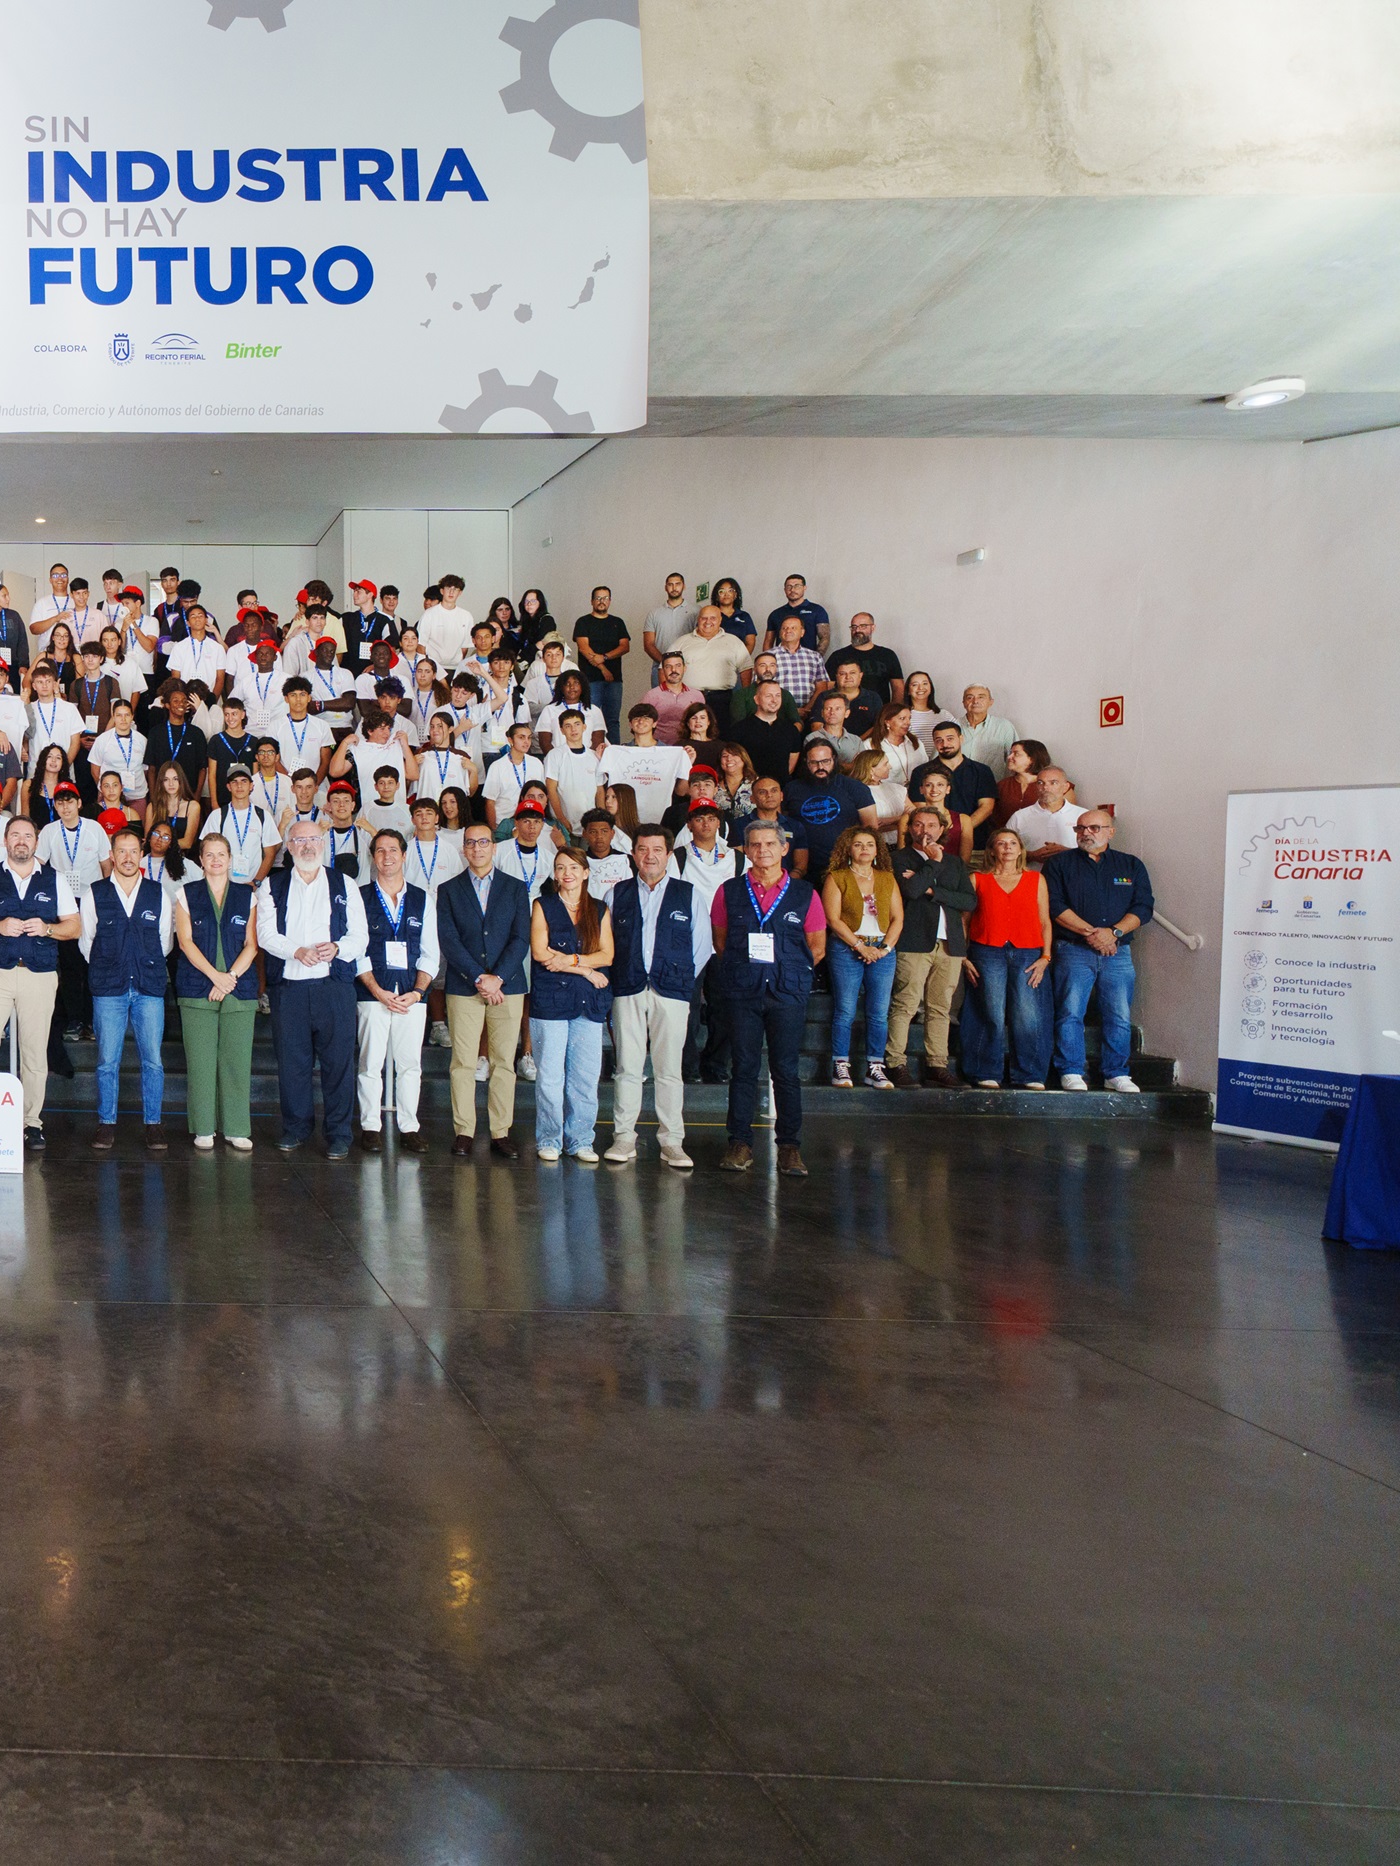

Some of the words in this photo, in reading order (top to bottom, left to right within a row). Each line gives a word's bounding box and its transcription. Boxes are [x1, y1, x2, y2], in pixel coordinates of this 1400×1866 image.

[24, 116, 90, 143] SIN
[28, 148, 489, 204] INDUSTRIA
[26, 208, 88, 238] NO
[105, 208, 187, 238] HAY
[28, 245, 375, 306] FUTURO
[34, 344, 88, 353] COLABORA
[225, 342, 282, 359] Binter
[0, 404, 49, 417] Industria,
[53, 404, 105, 416] Comercio
[108, 408, 115, 419] y
[118, 404, 182, 416] Autónomos
[185, 404, 202, 416] del
[204, 404, 255, 416] Gobierno
[258, 404, 272, 416] de
[275, 404, 325, 416] Canarias
[1274, 837, 1290, 845] DÍA
[1275, 849, 1392, 862] INDUSTRIA
[1274, 863, 1364, 880] Canaria
[1338, 909, 1367, 917] femete
[1274, 958, 1313, 967] Conoce
[1316, 960, 1326, 968] la
[1329, 960, 1377, 971] industria
[1273, 976, 1352, 989] Oportunidades
[1273, 986, 1295, 994] para
[1312, 987, 1345, 997] futuro
[1272, 999, 1328, 1011] Formación
[1281, 1009, 1333, 1020] desarrollo
[1271, 1023, 1328, 1036] Innovación
[1280, 1034, 1335, 1046] tecnología
[1238, 1071, 1274, 1082] Proyecto
[1276, 1077, 1340, 1091] subvencionado
[1252, 1089, 1292, 1100] Comercio
[1300, 1095, 1350, 1109] Autónomos
